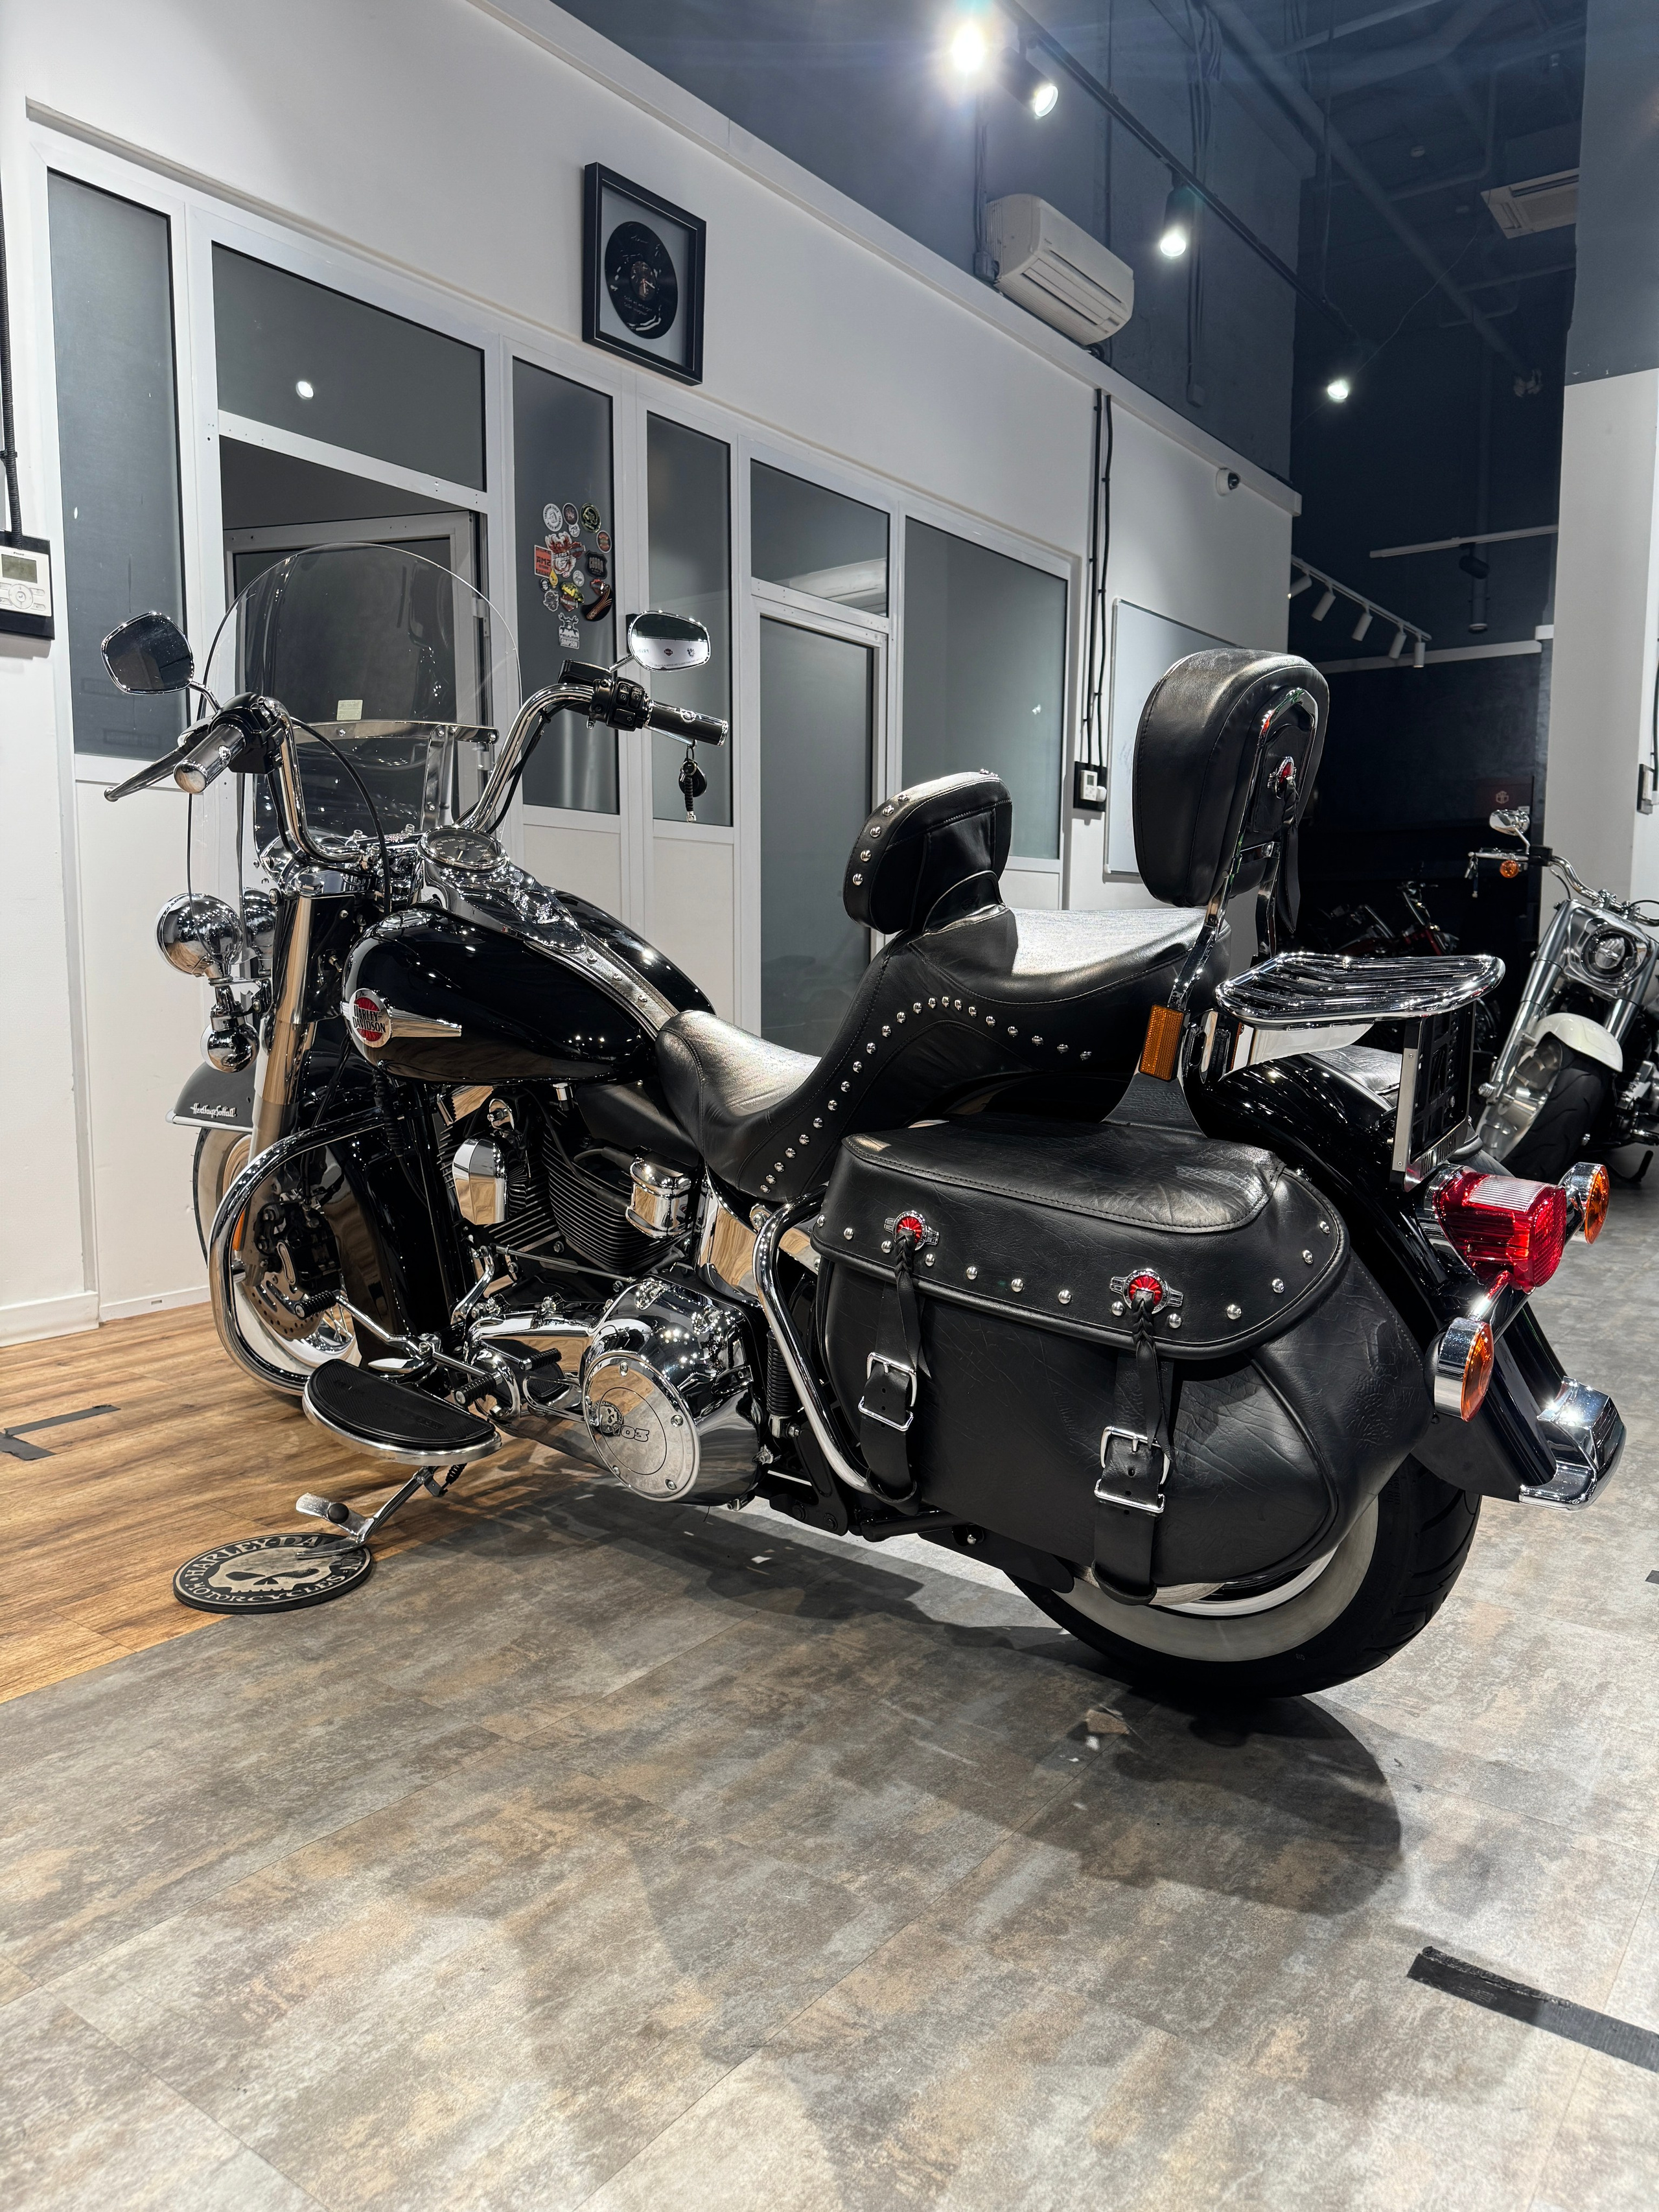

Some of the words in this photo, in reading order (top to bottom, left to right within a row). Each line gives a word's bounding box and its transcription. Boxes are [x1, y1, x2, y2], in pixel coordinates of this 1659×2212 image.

[354, 1005, 382, 1021] HARLEY-
[353, 1017, 386, 1032] DAVIDSON
[612, 1423, 650, 1443] 103
[184, 1575, 345, 1603] MOTORCYCLES
